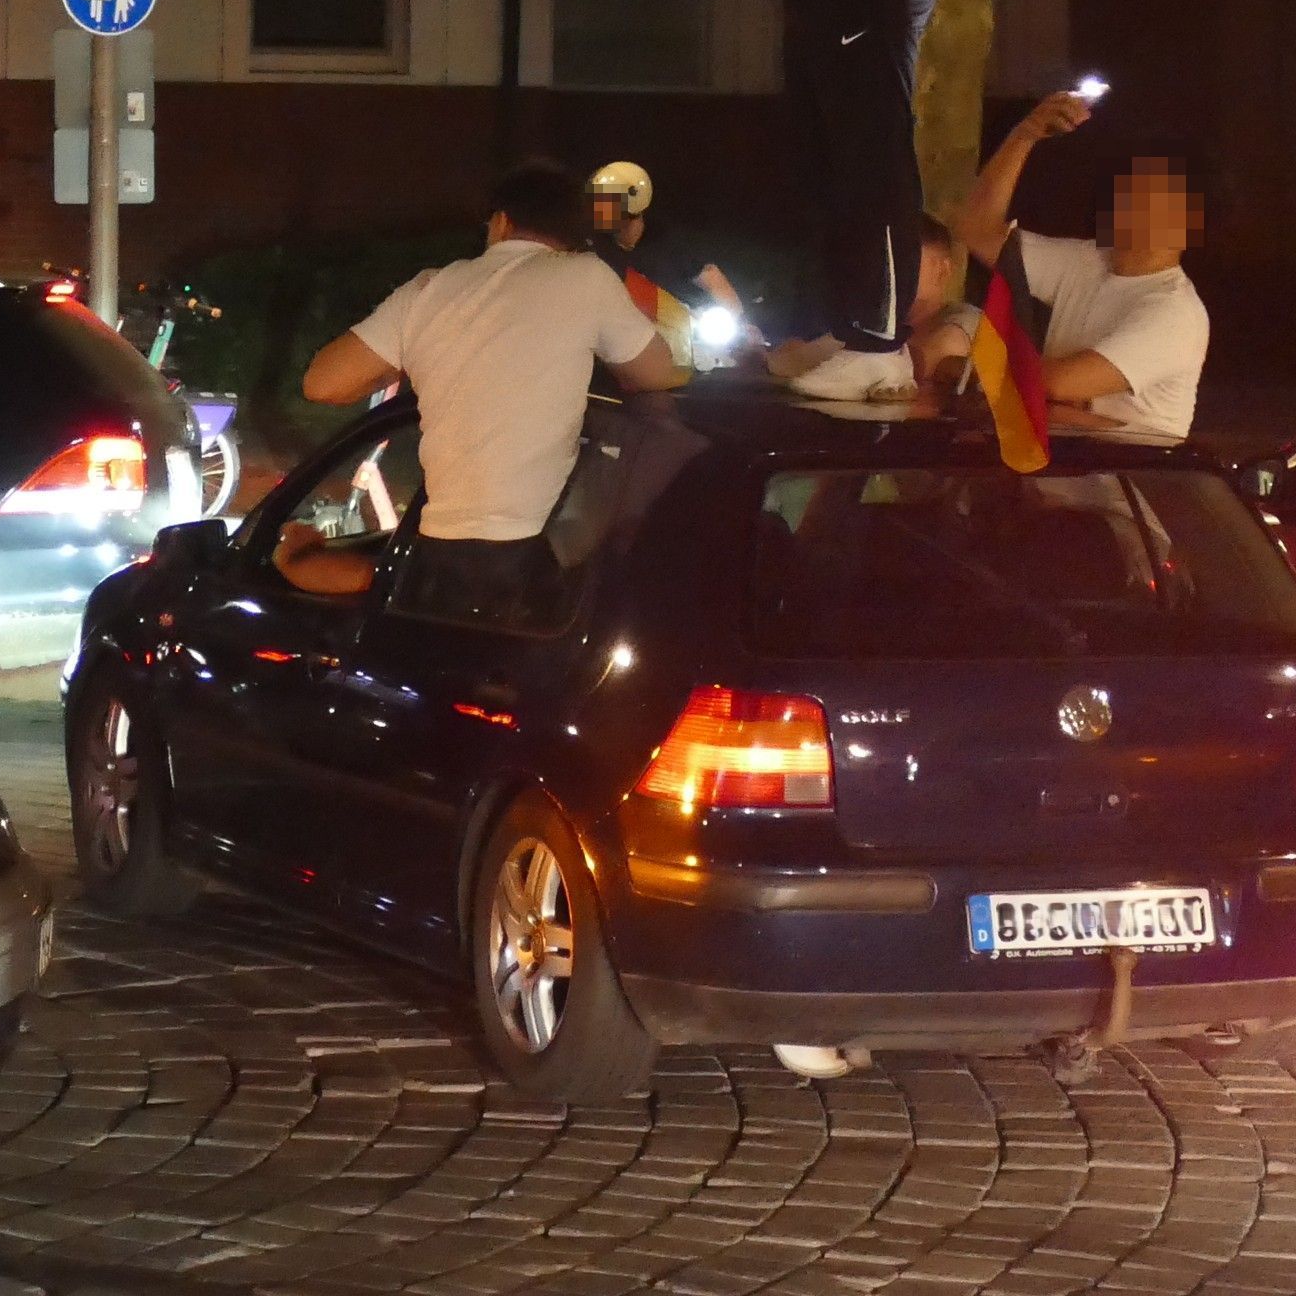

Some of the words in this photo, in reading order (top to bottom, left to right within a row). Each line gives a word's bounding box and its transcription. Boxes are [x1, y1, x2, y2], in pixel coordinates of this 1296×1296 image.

[840, 709, 911, 724] GOLF
[977, 929, 989, 943] D
[1025, 948, 1074, 958] Automobile
